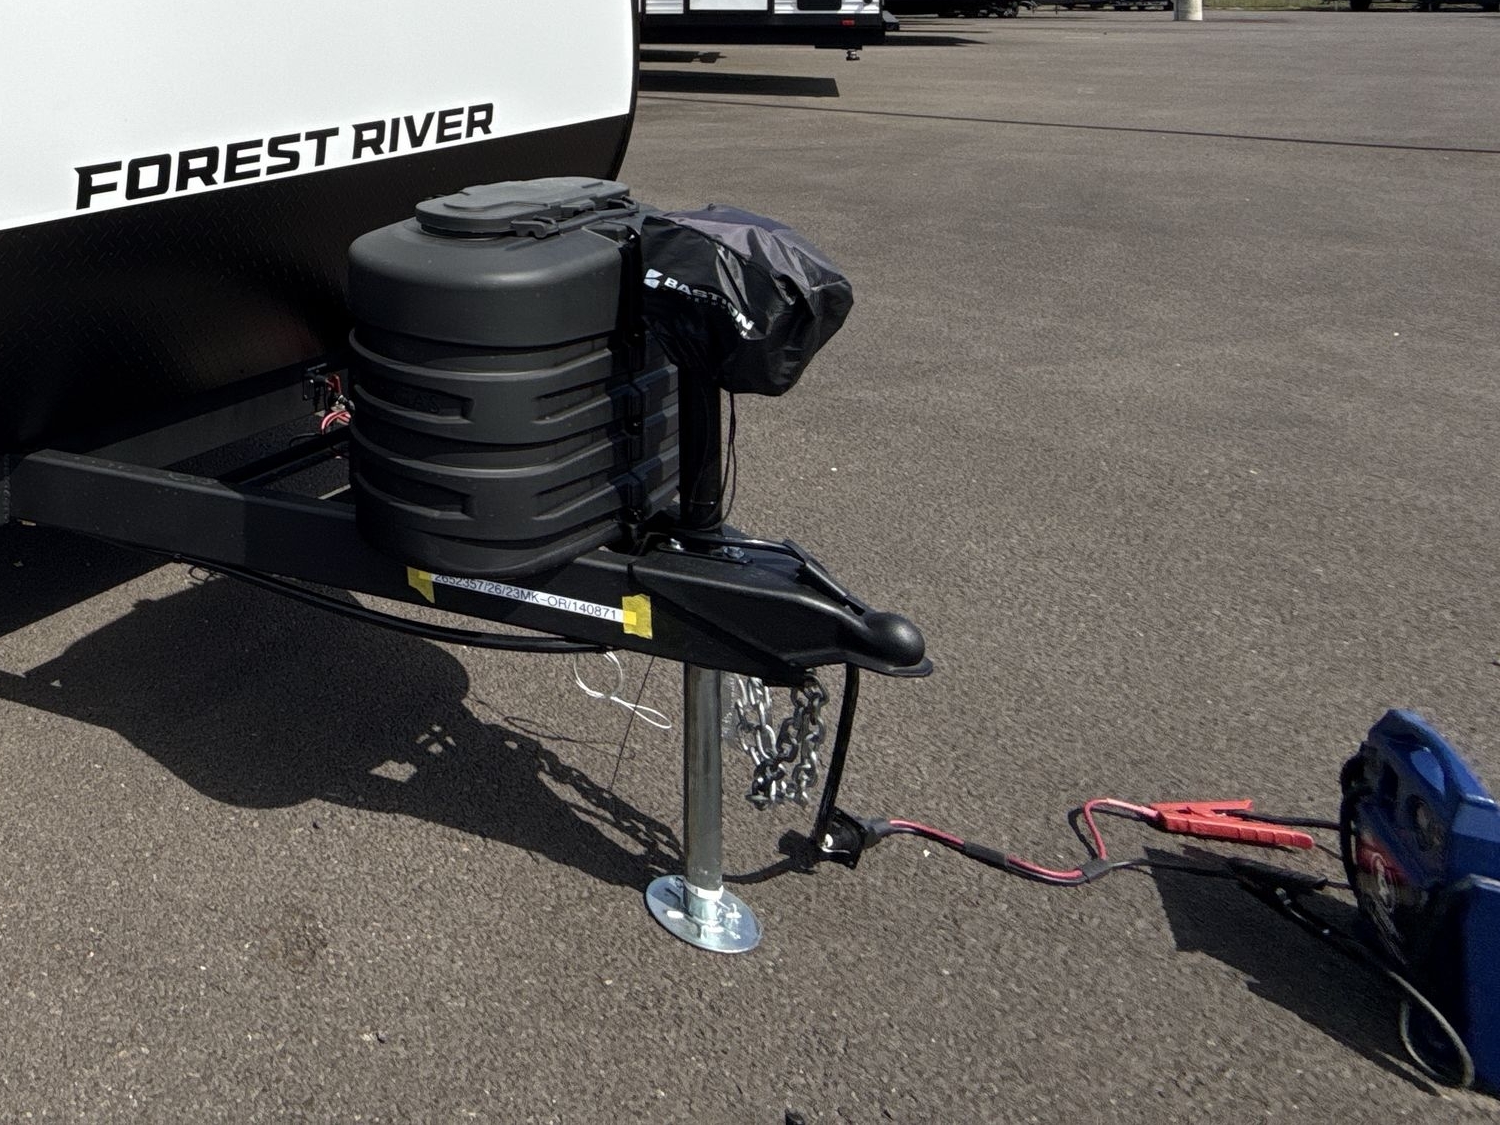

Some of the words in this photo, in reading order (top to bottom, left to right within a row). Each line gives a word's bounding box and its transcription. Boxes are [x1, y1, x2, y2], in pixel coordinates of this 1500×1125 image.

[74, 127, 339, 210] FOREST
[352, 103, 494, 159] RIVER
[664, 277, 754, 330] BASTION
